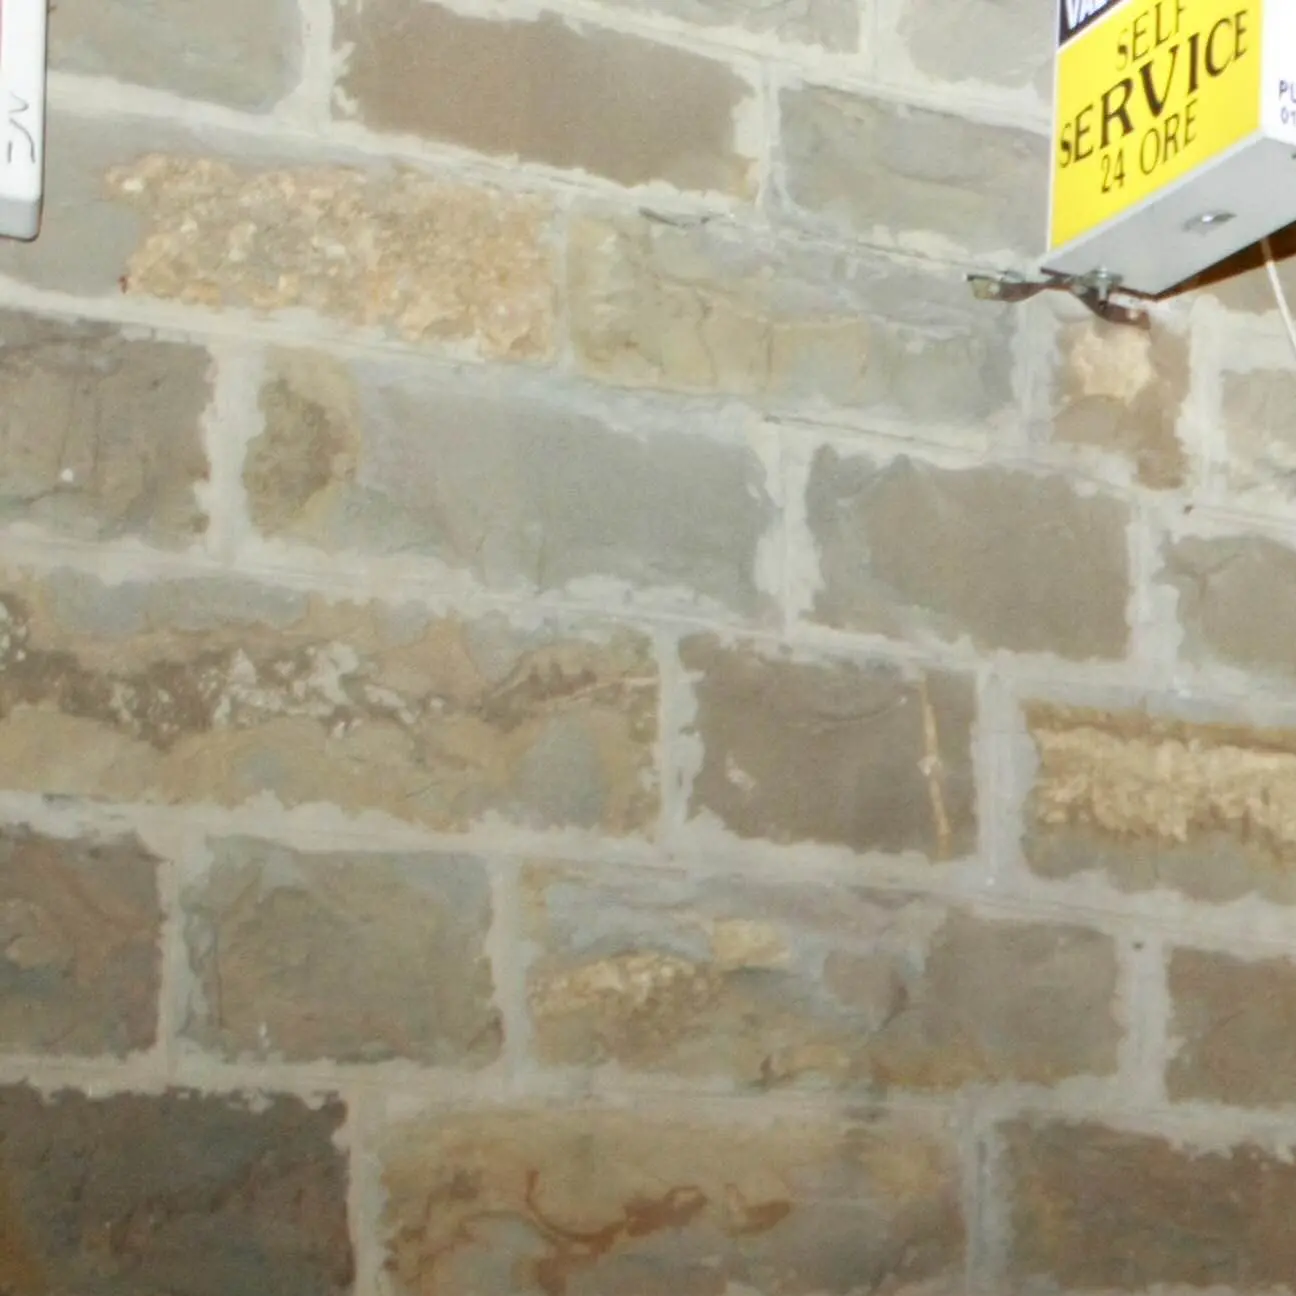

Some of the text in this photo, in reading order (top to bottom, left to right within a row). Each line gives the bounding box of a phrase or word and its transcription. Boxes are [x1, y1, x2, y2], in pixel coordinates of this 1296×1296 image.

[1116, 0, 1187, 70] SELF
[1058, 9, 1251, 170] SERVICE
[1100, 97, 1197, 195] 24 ORE
